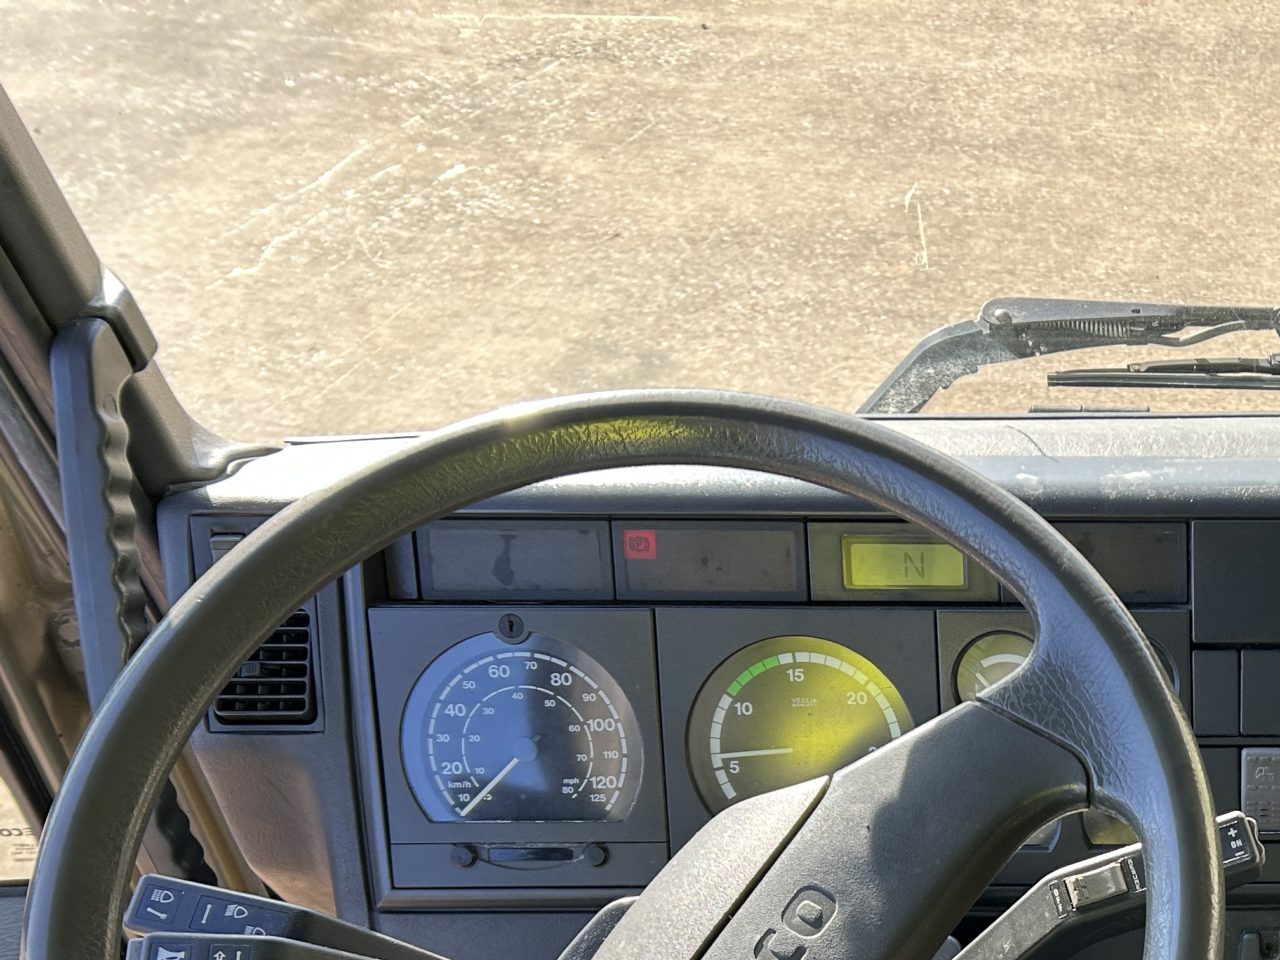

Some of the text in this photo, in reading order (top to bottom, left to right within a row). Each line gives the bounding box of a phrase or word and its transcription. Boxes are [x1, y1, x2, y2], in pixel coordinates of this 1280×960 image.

[904, 552, 925, 578] N
[525, 661, 537, 670] 70
[488, 664, 510, 678] 60
[786, 668, 804, 682] 15
[550, 672, 572, 686] 80
[462, 681, 476, 689] 50
[511, 692, 524, 700] 40
[582, 693, 596, 702] 90
[846, 691, 868, 705] 20
[544, 699, 556, 707] 50
[444, 703, 466, 717] 40
[482, 707, 495, 715] 30
[734, 702, 753, 715] 10
[568, 724, 581, 732] 60
[586, 718, 616, 732] 100
[436, 734, 450, 742] 30
[576, 754, 588, 762] 70
[602, 751, 619, 759] 110
[441, 762, 463, 775] 20
[474, 767, 485, 775] 10
[729, 761, 740, 773] 5
[447, 780, 472, 788] km/h
[563, 778, 579, 786] mph
[589, 776, 617, 789] 120
[562, 786, 574, 794] 80
[458, 793, 470, 802] 10
[589, 793, 607, 802] 125
